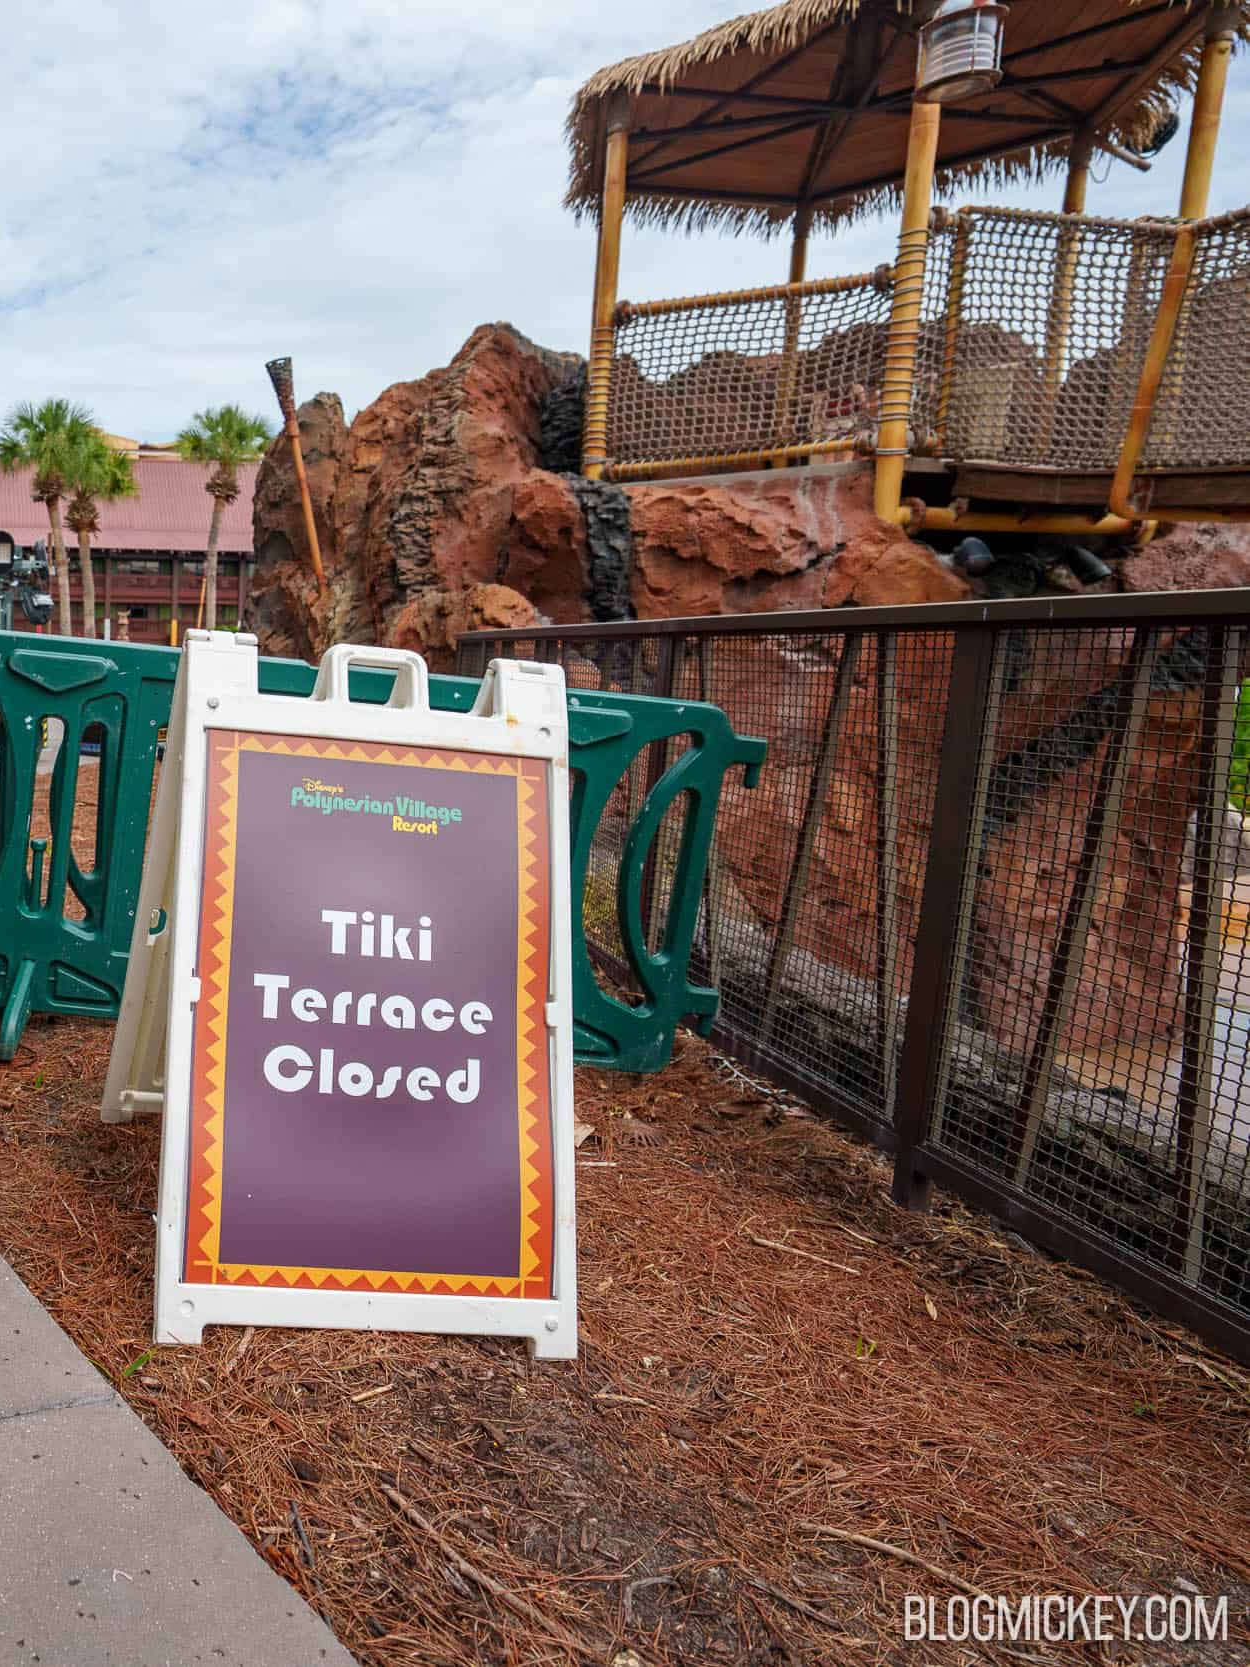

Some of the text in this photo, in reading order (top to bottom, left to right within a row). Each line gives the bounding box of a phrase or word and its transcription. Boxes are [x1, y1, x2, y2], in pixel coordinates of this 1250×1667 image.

[290, 786, 463, 826] Polynesian Village
[301, 777, 345, 795] Disney's
[392, 815, 438, 835] Resort
[321, 909, 432, 961] Tiki
[253, 973, 493, 1035] Terrace
[263, 1044, 481, 1104] Closed
